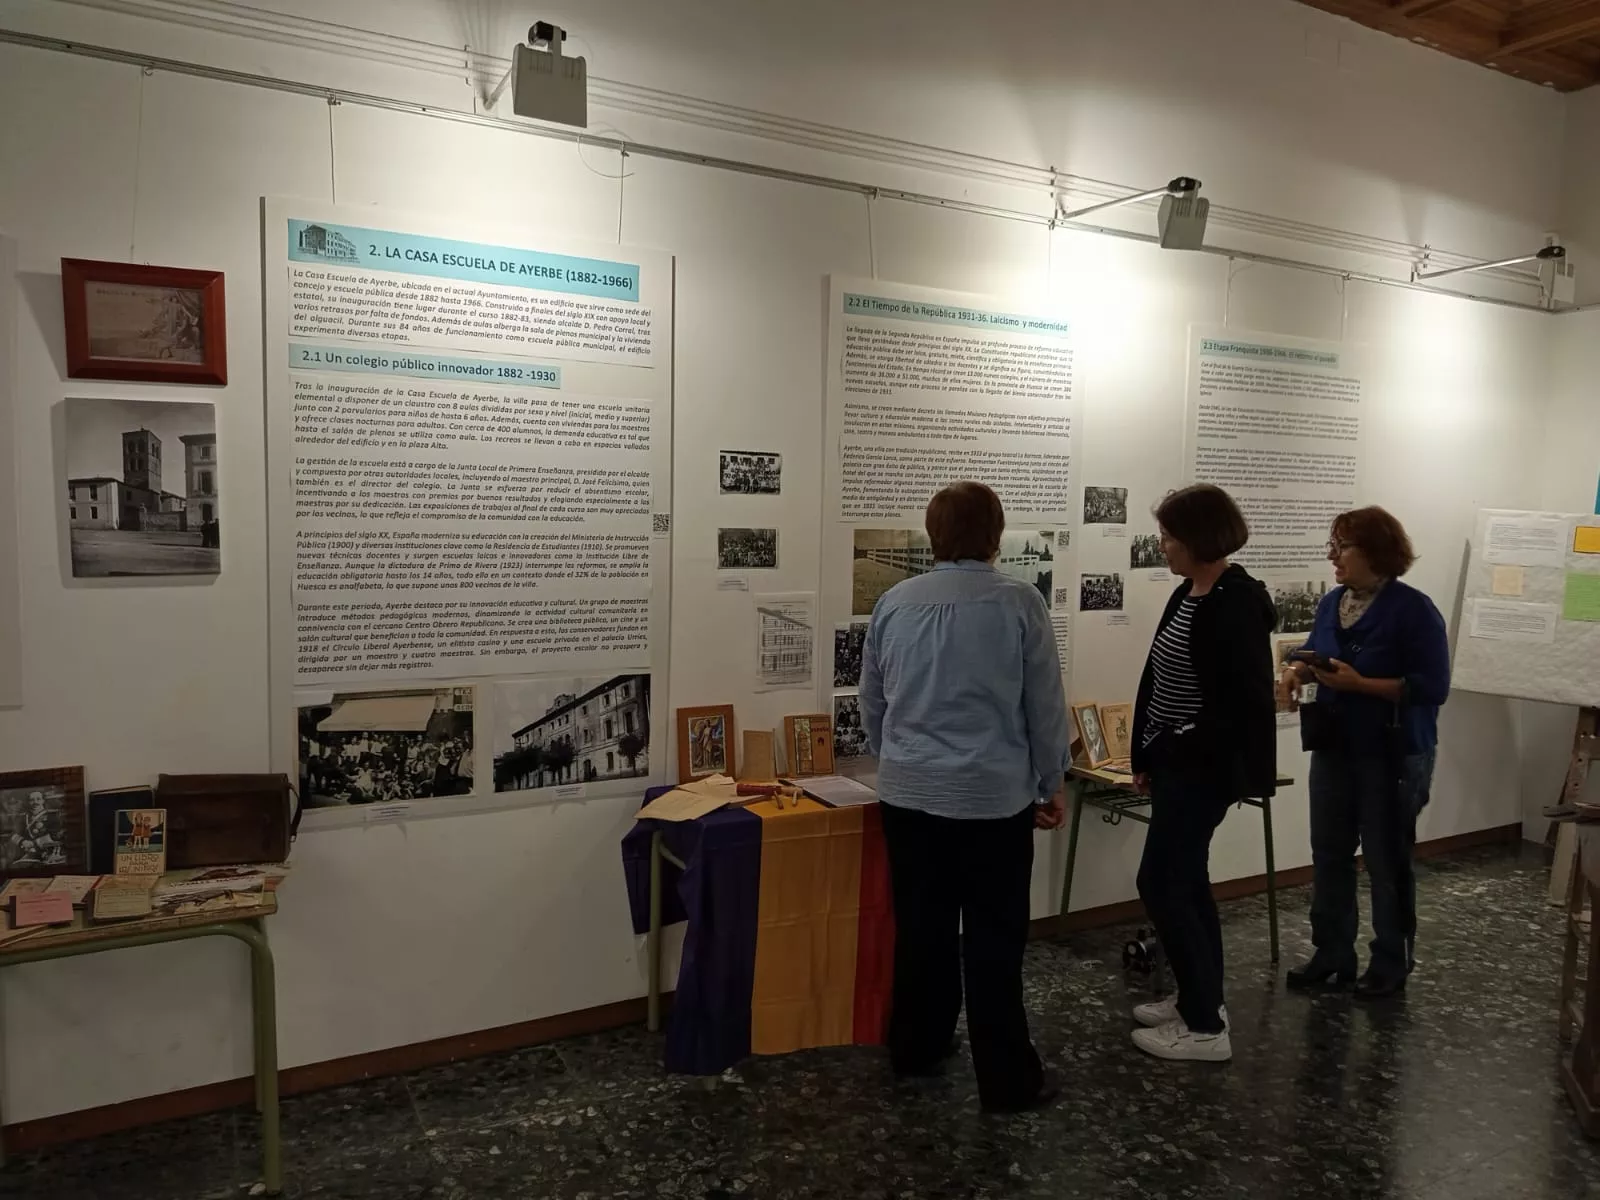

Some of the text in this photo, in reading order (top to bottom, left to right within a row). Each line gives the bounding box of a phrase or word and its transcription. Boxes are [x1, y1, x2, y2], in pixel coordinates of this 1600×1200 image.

[369, 245, 632, 290] 2. LA CASA ESCUELA DE AYERBE (1882-1966)
[305, 271, 325, 279] Casa
[327, 273, 357, 282] Escuela
[370, 277, 399, 287] Ayerbe,
[402, 280, 431, 290] ubicada
[453, 287, 476, 295] actual
[477, 289, 528, 303] Ayuntamiento,
[550, 299, 574, 308] edificio
[293, 282, 325, 291] concejo
[365, 288, 393, 297] pública
[395, 290, 418, 299] desde
[420, 293, 438, 302] 1882
[441, 295, 462, 304] hasta
[463, 298, 483, 306] 1966.
[485, 300, 523, 311] Construido
[531, 306, 553, 315] finales
[567, 310, 582, 319] siglo
[630, 317, 646, 325] local
[848, 298, 860, 307] 2.2
[863, 300, 870, 308] El
[872, 301, 899, 312] Tiempo
[901, 304, 910, 313] de
[913, 305, 919, 314] la
[921, 307, 956, 319] República
[990, 316, 1020, 326] Laicismo
[1028, 321, 1068, 331] modernidad
[294, 325, 410, 341] experimenta diversas etapas.
[1214, 343, 1229, 352] Etapa
[302, 351, 556, 381] 2.1 Un colegio público innovador 1882 -1930
[295, 382, 312, 390] Tras
[328, 384, 379, 394] inauguración
[408, 389, 426, 397] Casa
[429, 391, 457, 400] Escuela
[473, 394, 500, 403] Ayerbe,
[295, 436, 334, 444] alrededor
[351, 438, 379, 447] edificio
[408, 441, 429, 449] plaza
[326, 510, 358, 519] vecinos,
[386, 511, 410, 520] refleja
[421, 512, 466, 520] compromiso
[304, 530, 343, 540] principios
[358, 531, 376, 540] siglo
[392, 531, 420, 540] España
[385, 602, 412, 611] Ayerbe
[298, 665, 344, 674] desaparece
[359, 663, 378, 672] dejar
